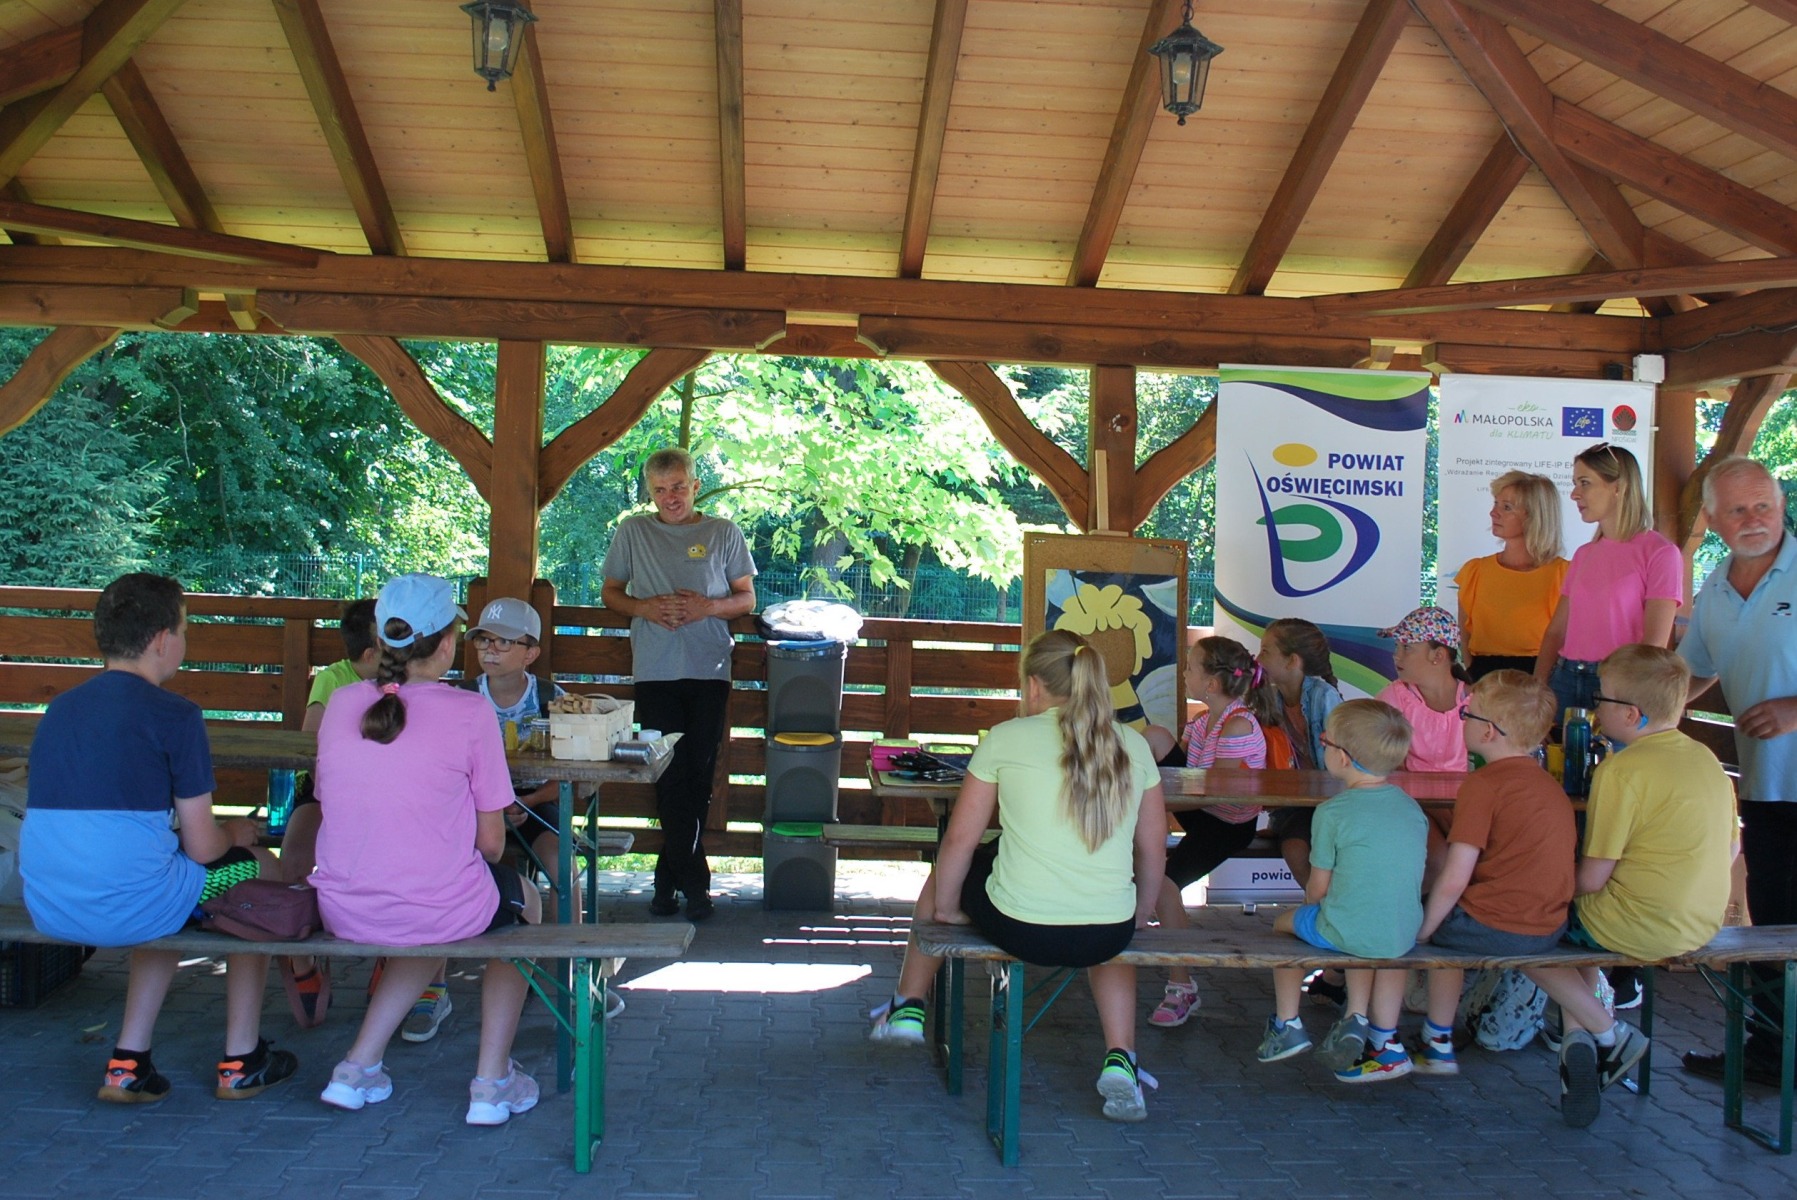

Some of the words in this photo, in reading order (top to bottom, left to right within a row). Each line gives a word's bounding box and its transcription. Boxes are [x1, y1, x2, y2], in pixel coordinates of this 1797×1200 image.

[1472, 414, 1553, 427] MAŁOPOLSKA
[1507, 430, 1554, 440] KLIMATU
[1328, 453, 1404, 471] POWIAT
[1456, 457, 1483, 466] Projekt
[1485, 460, 1533, 468] zintegrowany
[1534, 461, 1563, 469] LIFE-IP
[1266, 472, 1404, 498] OŚWIĘCIMSKI
[1252, 869, 1294, 884] powia
